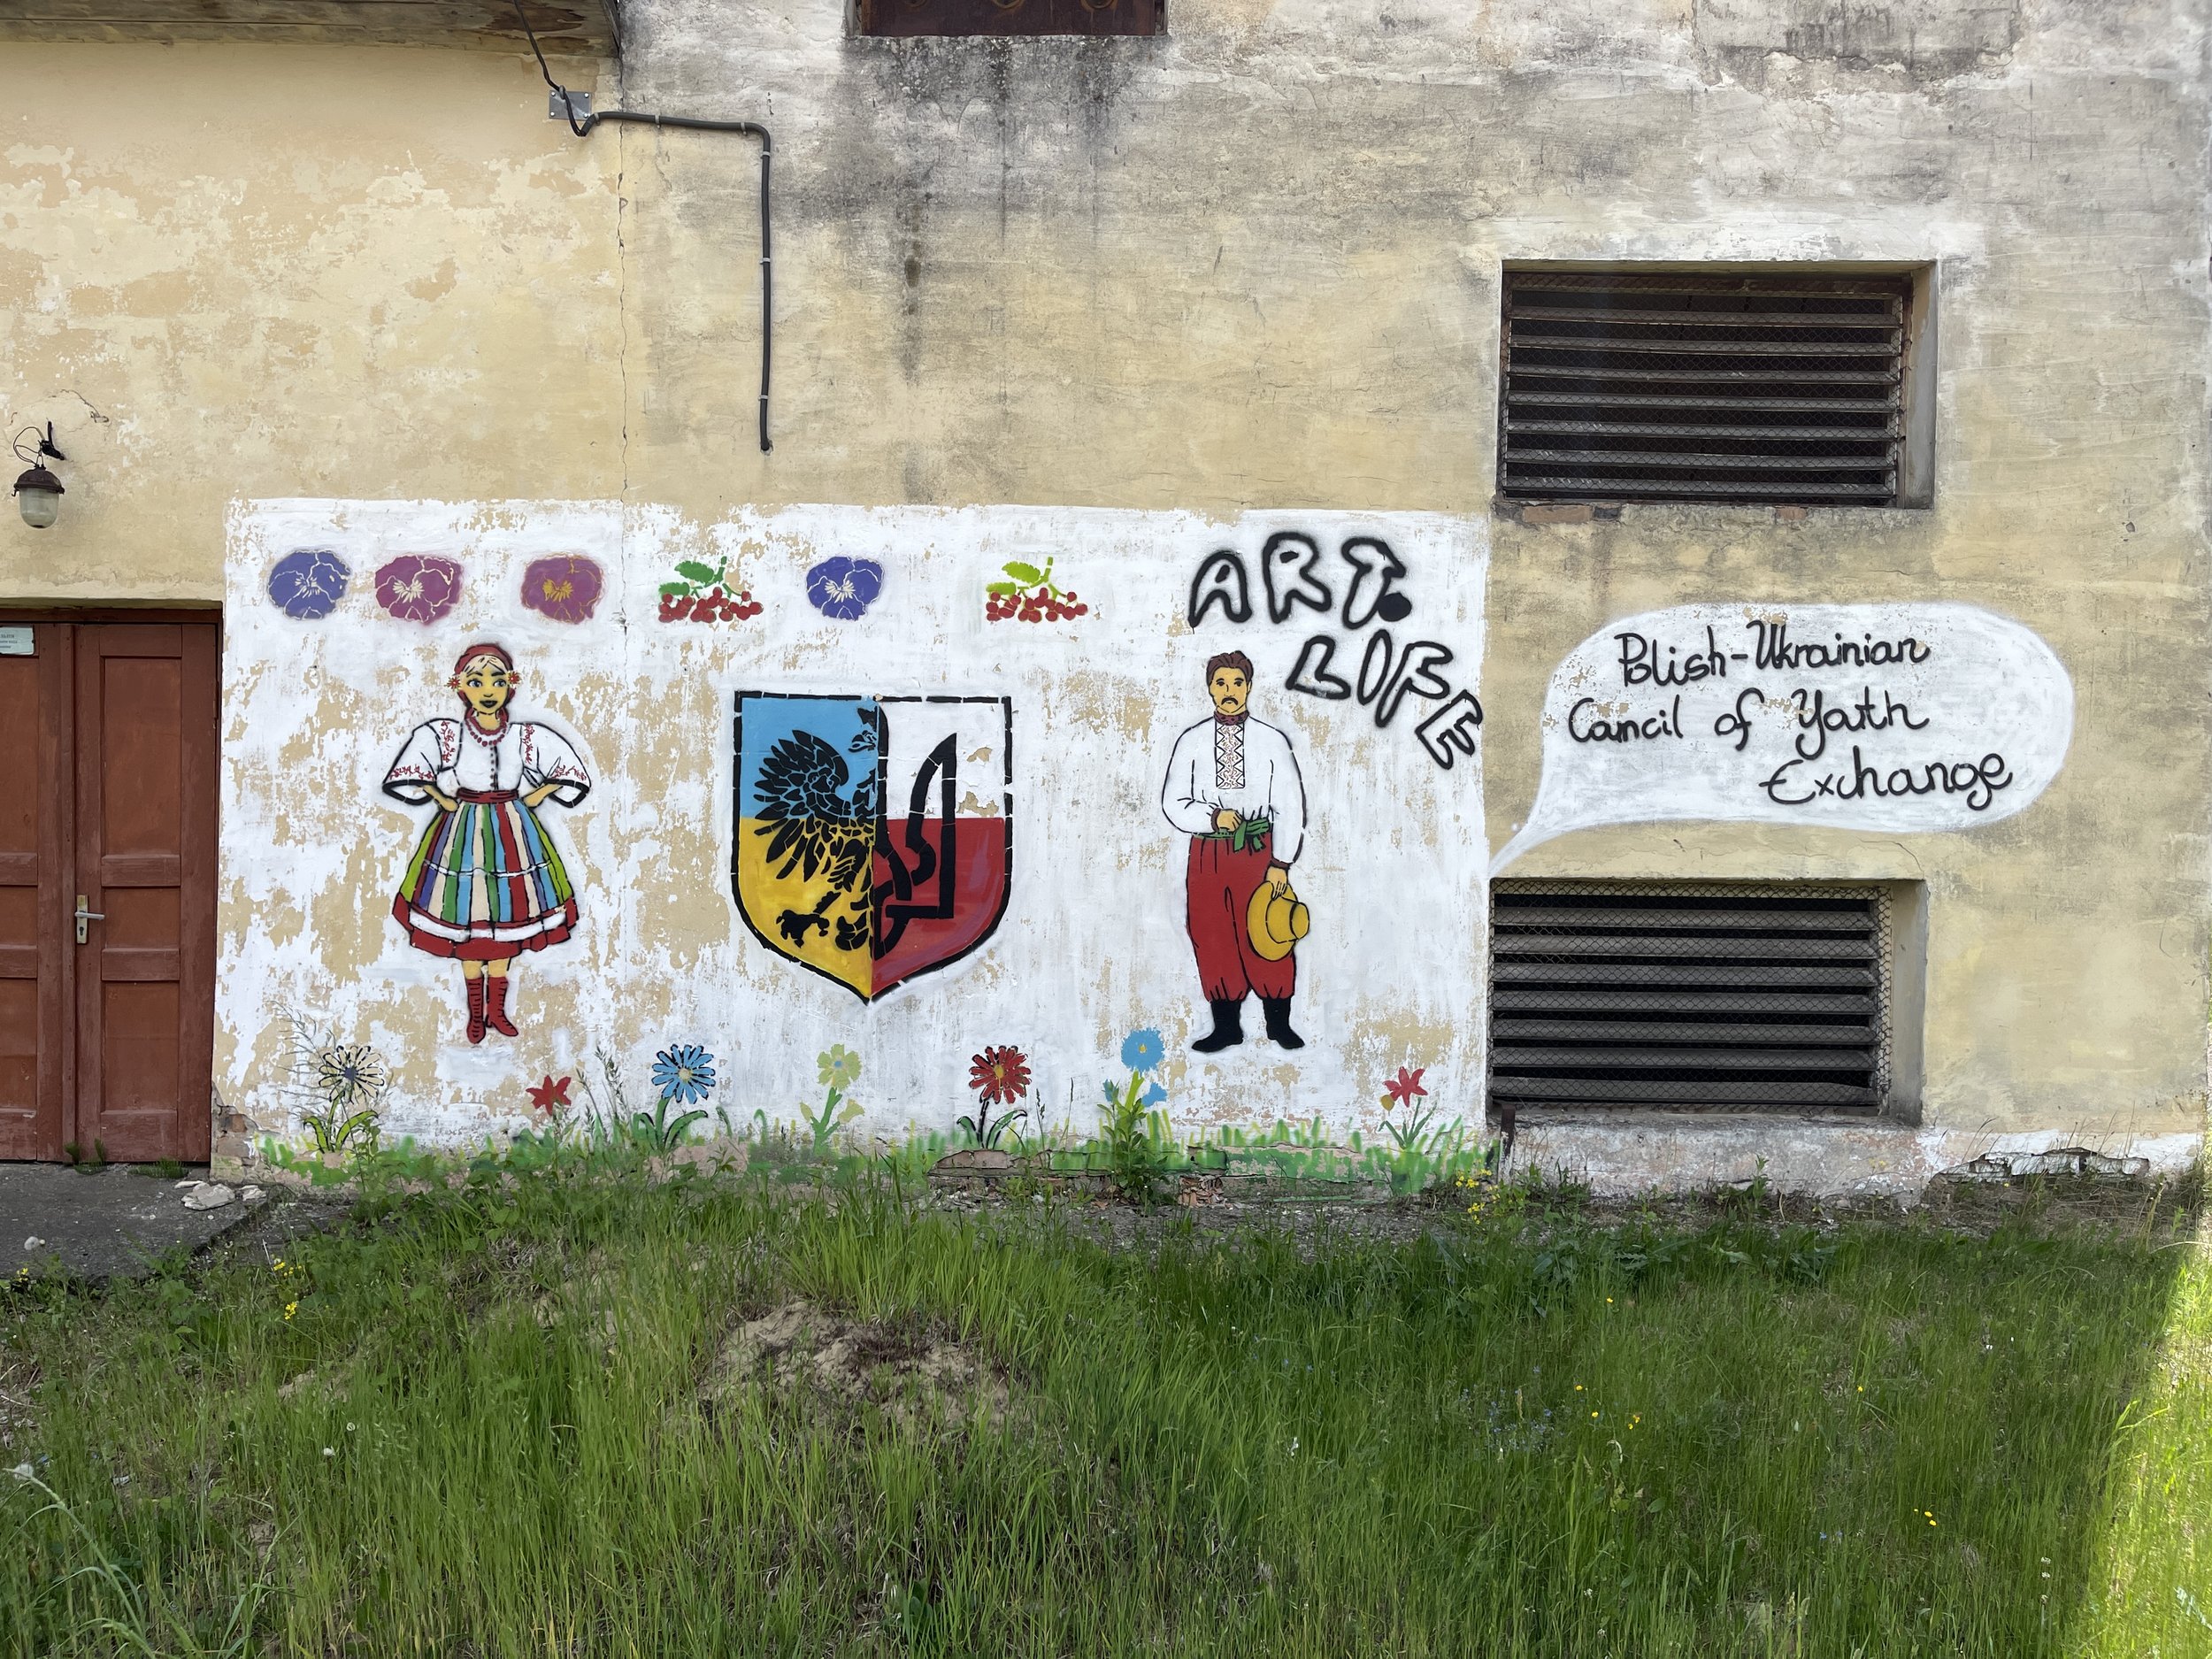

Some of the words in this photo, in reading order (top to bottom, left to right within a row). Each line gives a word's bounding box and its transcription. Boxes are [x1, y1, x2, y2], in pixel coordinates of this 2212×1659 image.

[1285, 628, 1485, 771] LIFE
[1714, 687, 1765, 752] of
[1759, 745, 2013, 811] Exchange
